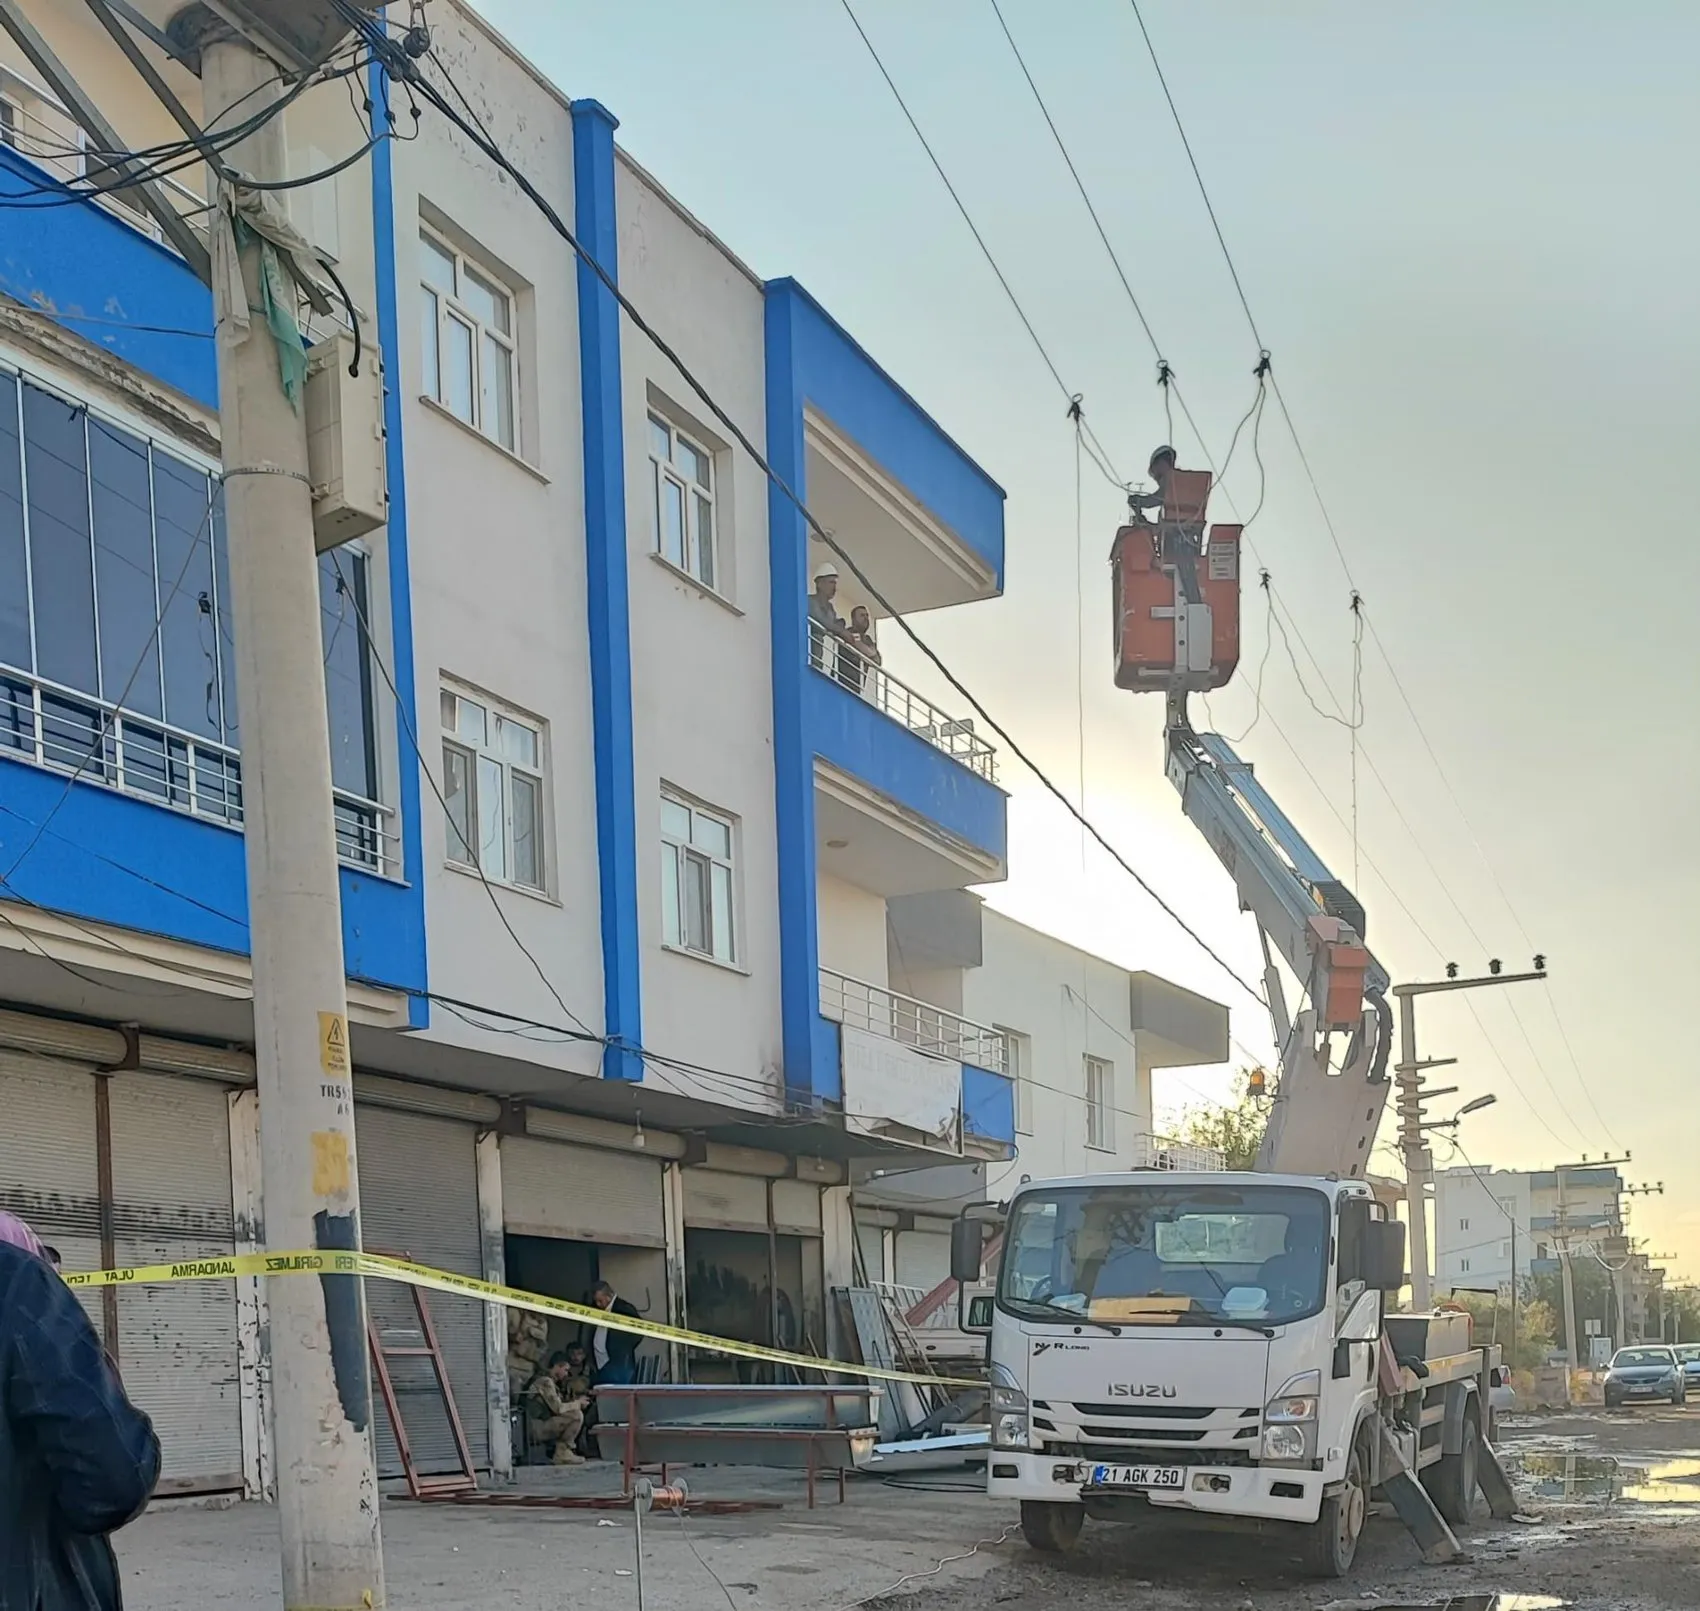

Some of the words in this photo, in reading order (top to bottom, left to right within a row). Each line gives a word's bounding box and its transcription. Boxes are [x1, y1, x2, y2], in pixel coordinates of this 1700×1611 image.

[1108, 1383, 1177, 1398] ISUZU
[1102, 1467, 1118, 1482] 21
[1123, 1468, 1150, 1483] AGK
[1153, 1469, 1179, 1485] 250
